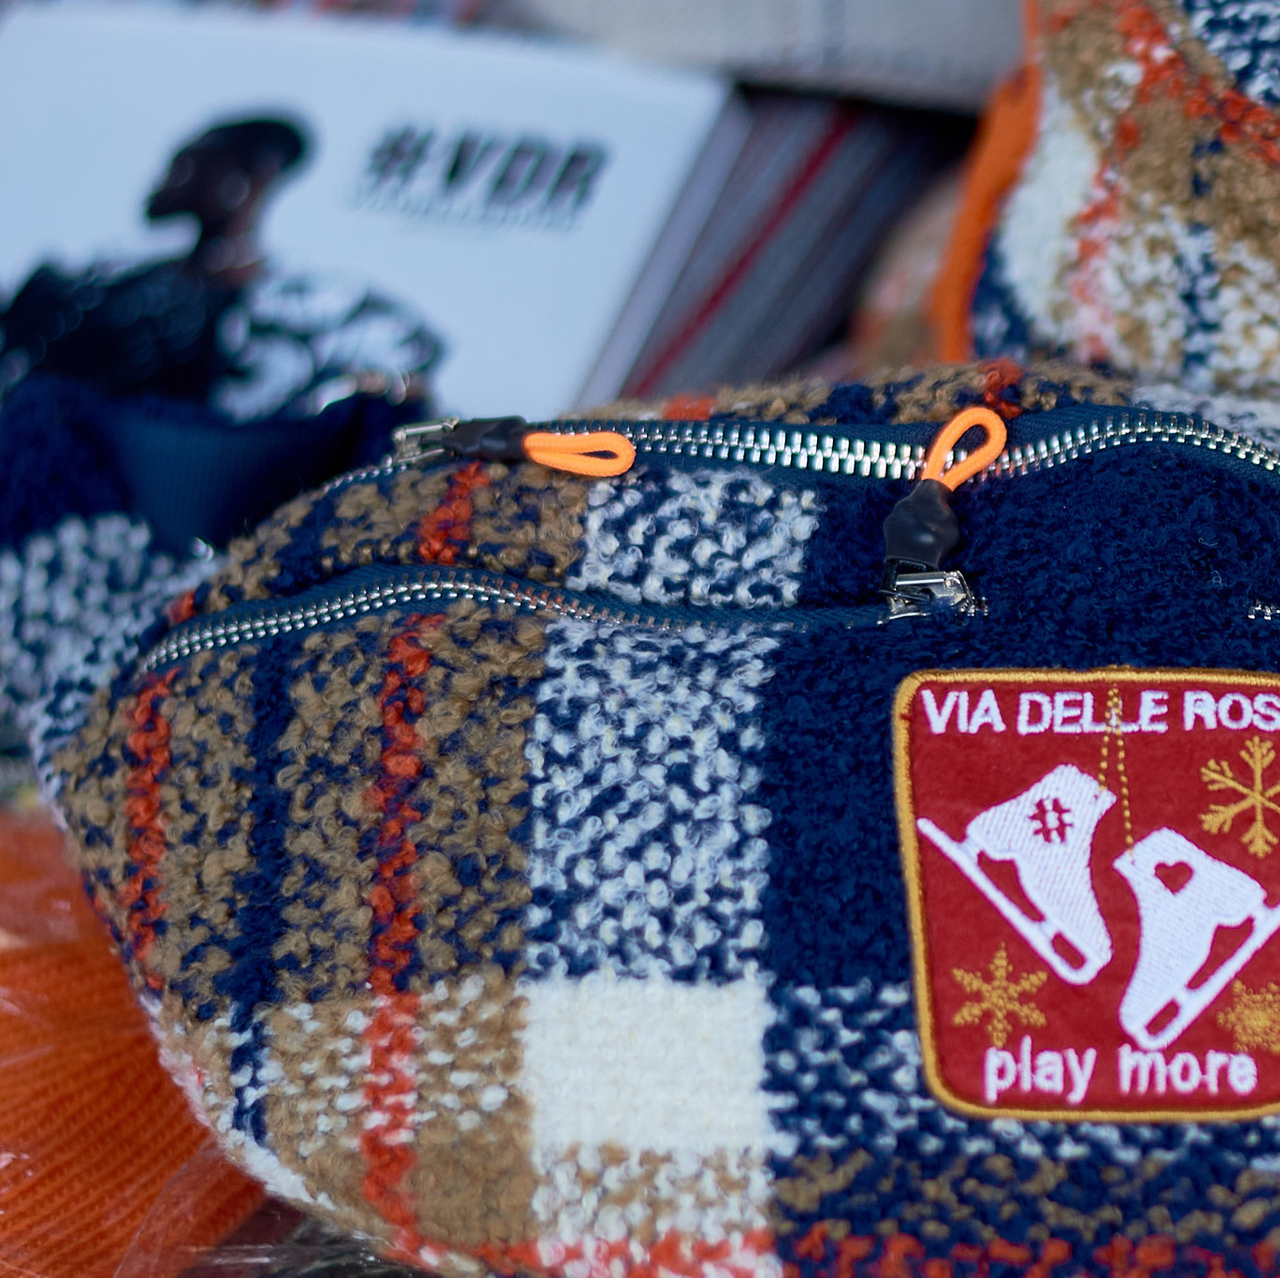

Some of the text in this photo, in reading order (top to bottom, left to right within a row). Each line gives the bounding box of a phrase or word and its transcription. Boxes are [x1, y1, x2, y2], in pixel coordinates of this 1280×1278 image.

[920, 688, 1006, 735] VIA
[1016, 689, 1170, 737] DELLE
[984, 1035, 1259, 1106] play more
